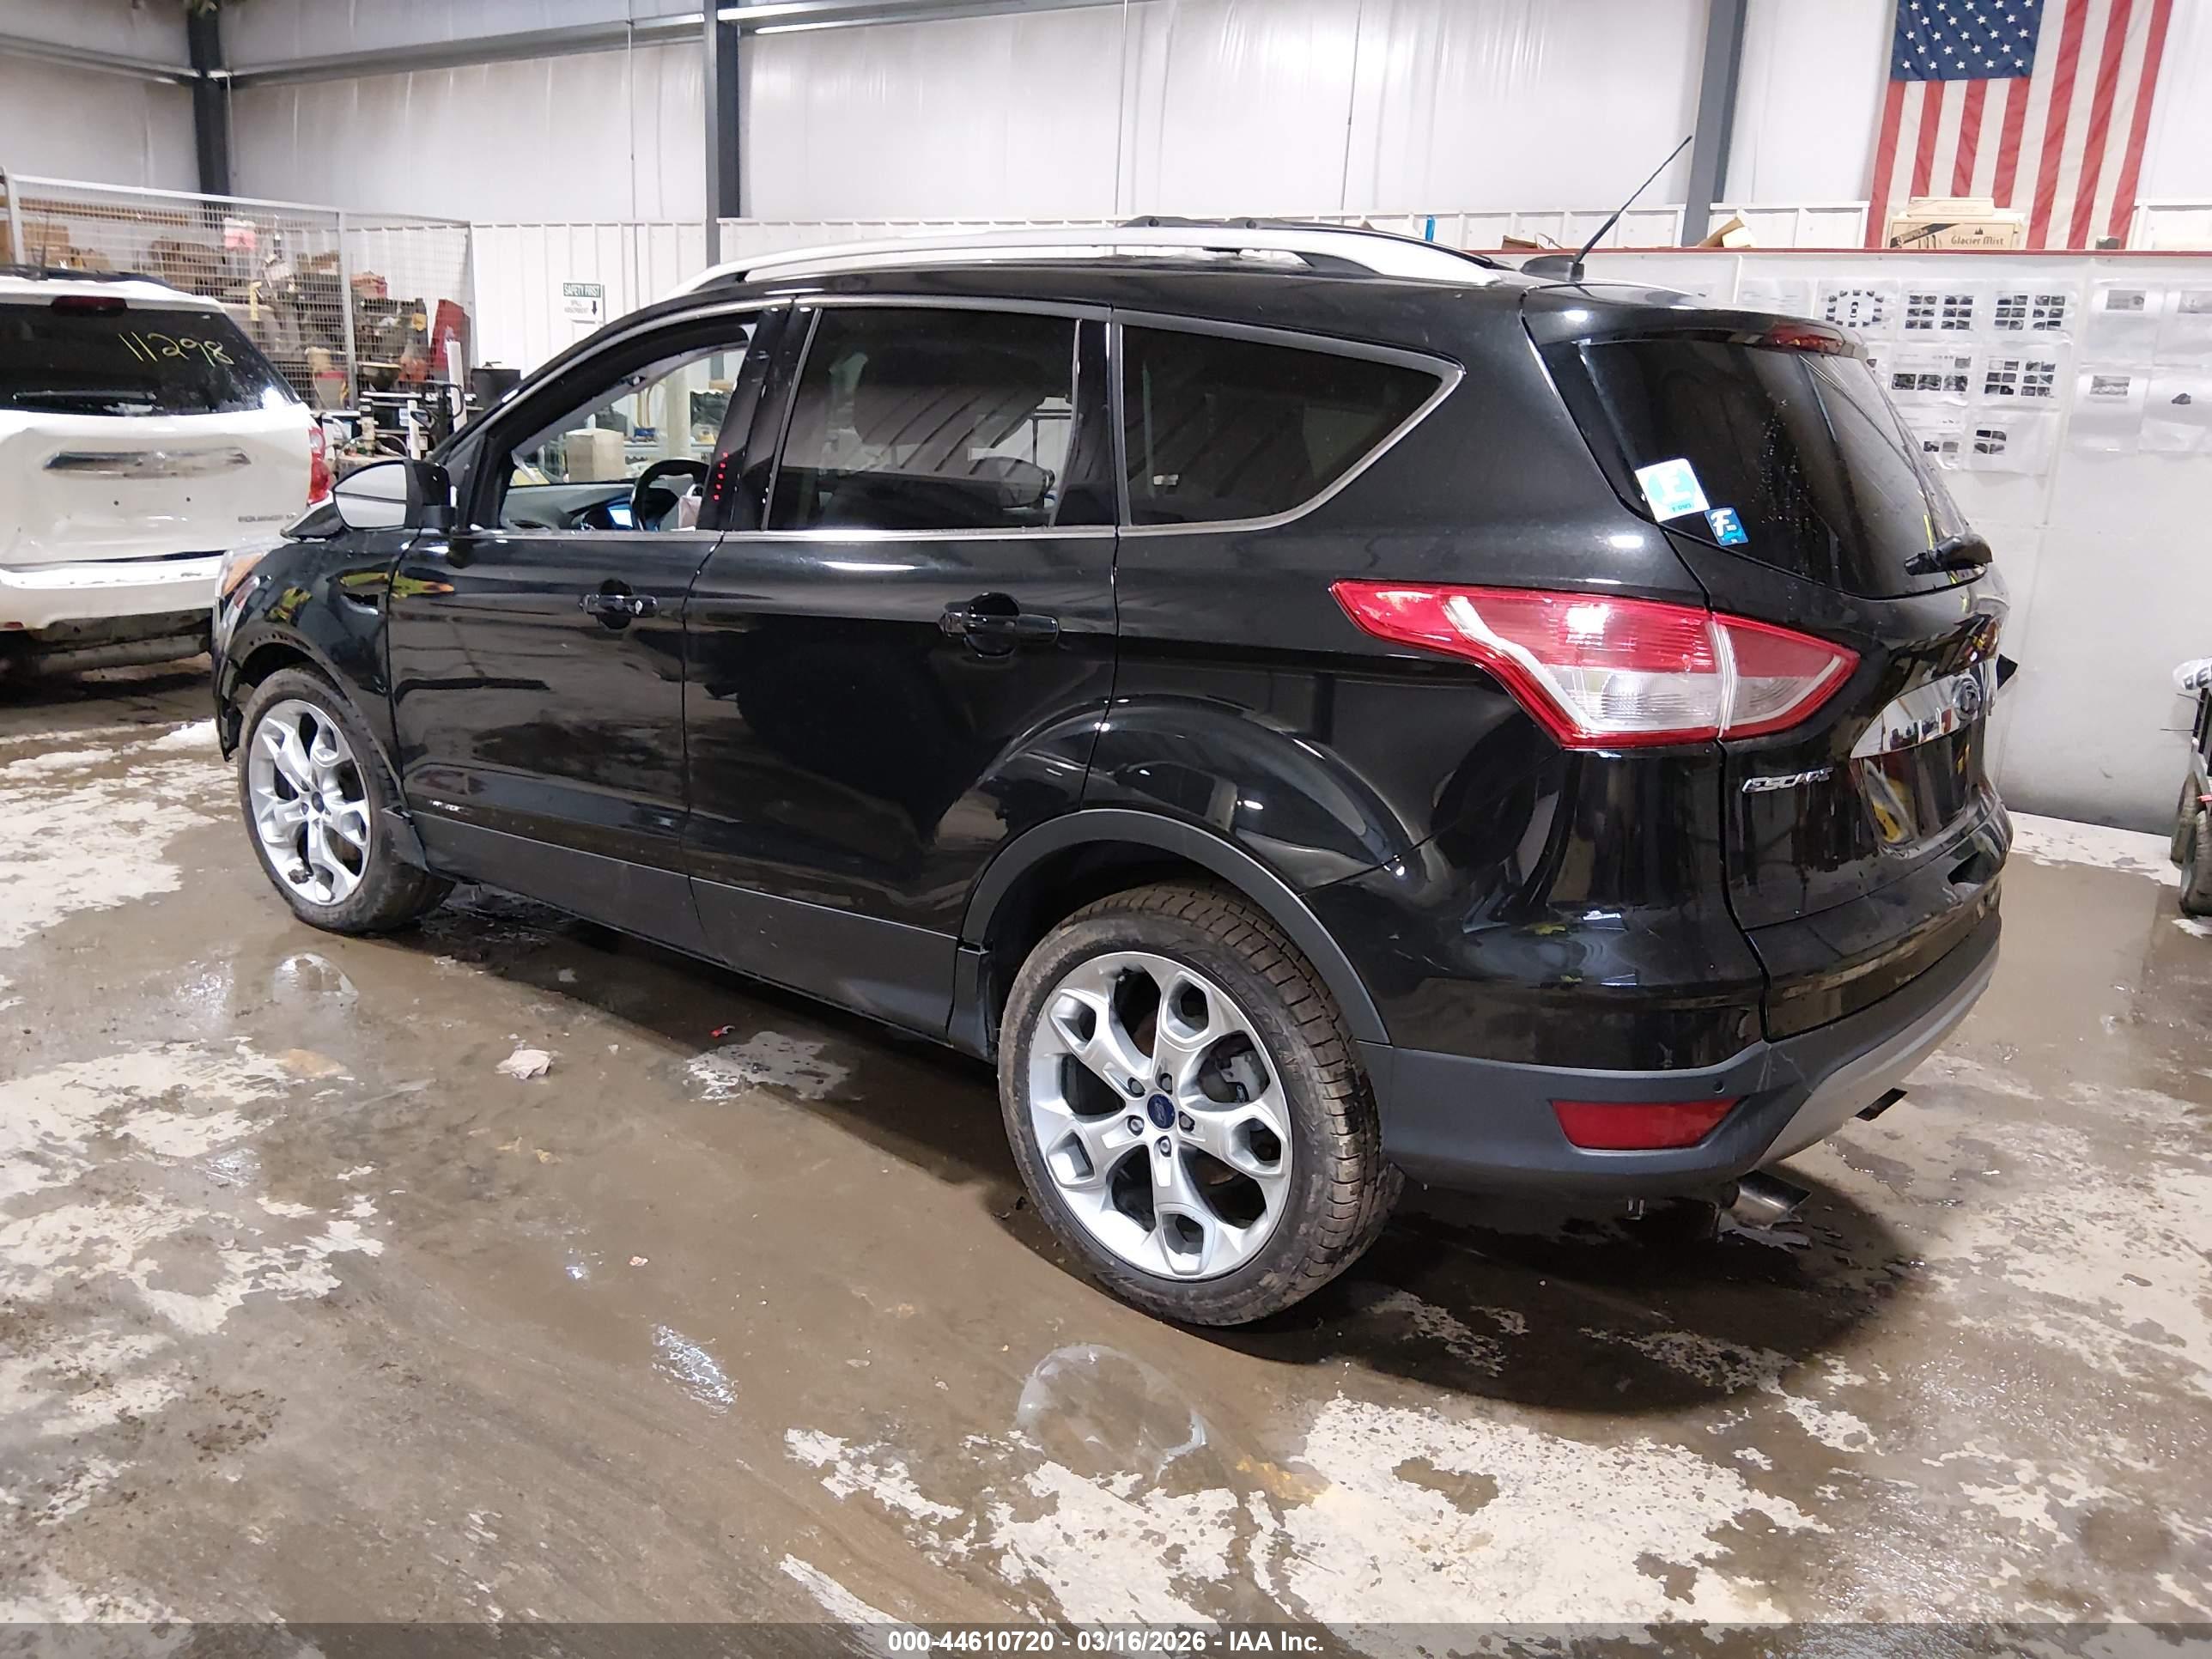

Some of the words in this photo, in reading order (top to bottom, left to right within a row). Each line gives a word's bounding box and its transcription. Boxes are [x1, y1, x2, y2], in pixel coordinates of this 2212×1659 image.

[1951, 234, 1980, 246] Glacier
[1983, 235, 2003, 246] Mist
[118, 331, 235, 368] 11298
[1741, 767, 1834, 793] ESCAPE
